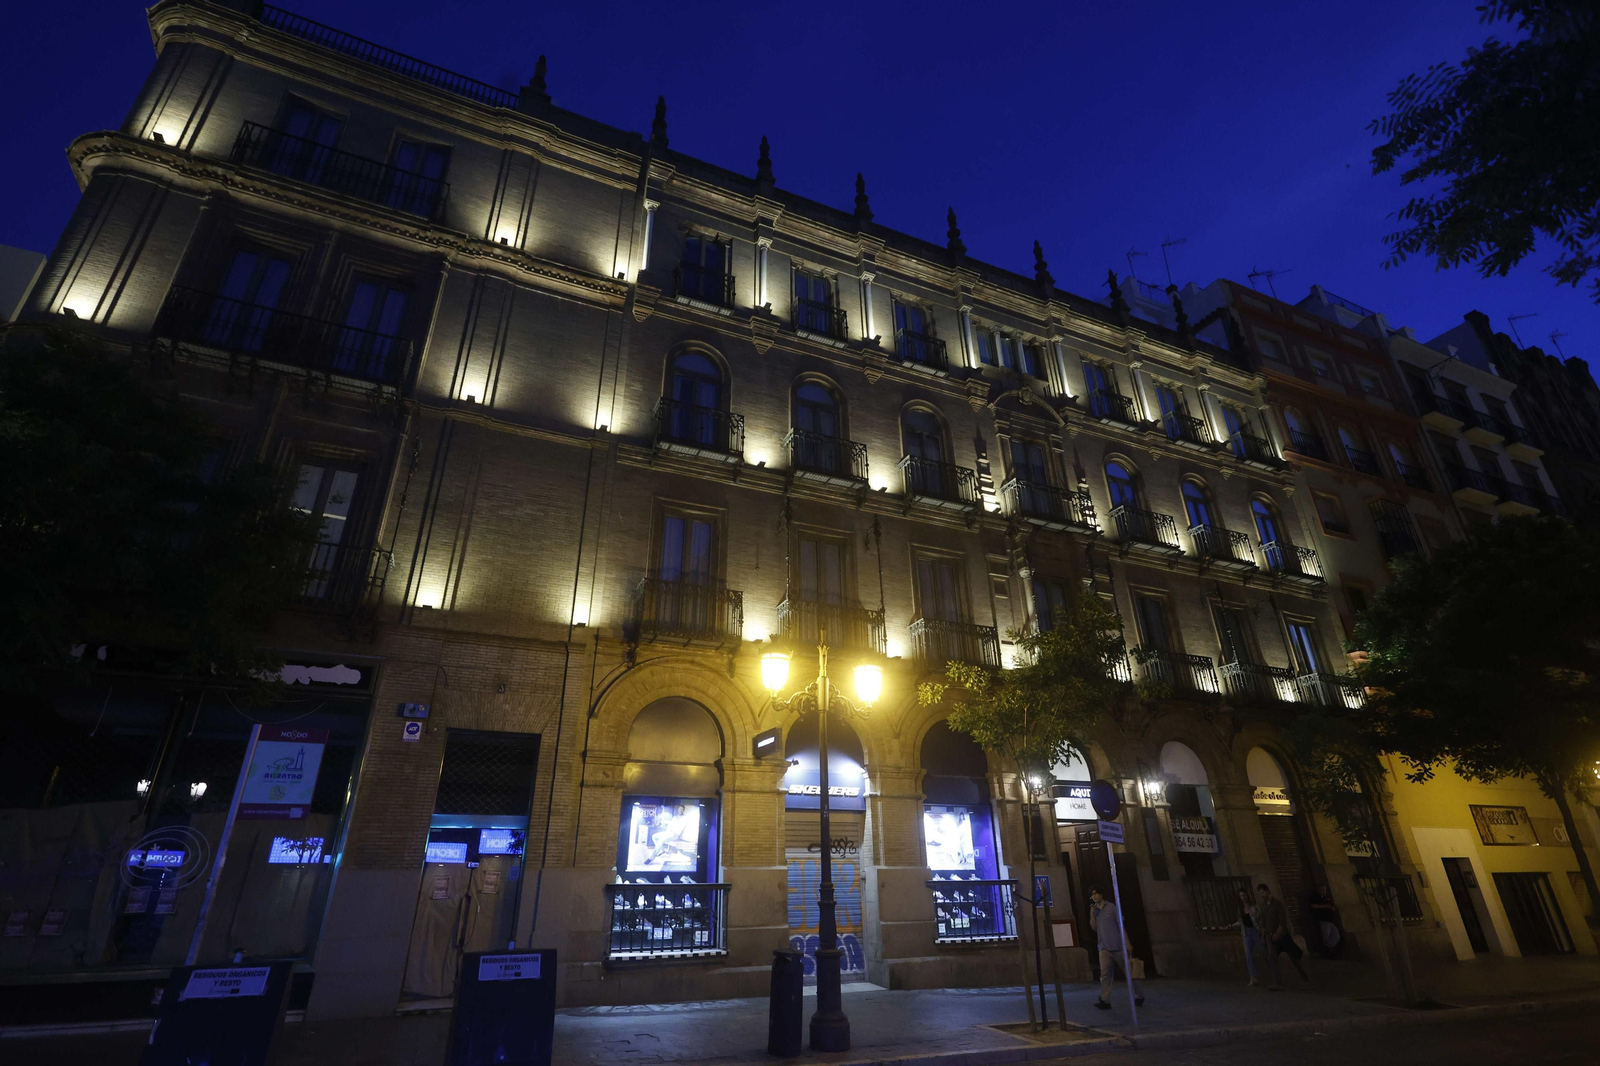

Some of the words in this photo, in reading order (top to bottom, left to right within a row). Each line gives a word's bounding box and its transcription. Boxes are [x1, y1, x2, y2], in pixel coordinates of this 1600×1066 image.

[1070, 802, 1088, 810] HOME
[1171, 819, 1180, 830] SE
[1187, 836, 1196, 848] 56
[193, 970, 227, 979] RESIDUOS
[228, 969, 267, 978] ORGÁNICOS
[219, 979, 242, 987] RESTO
